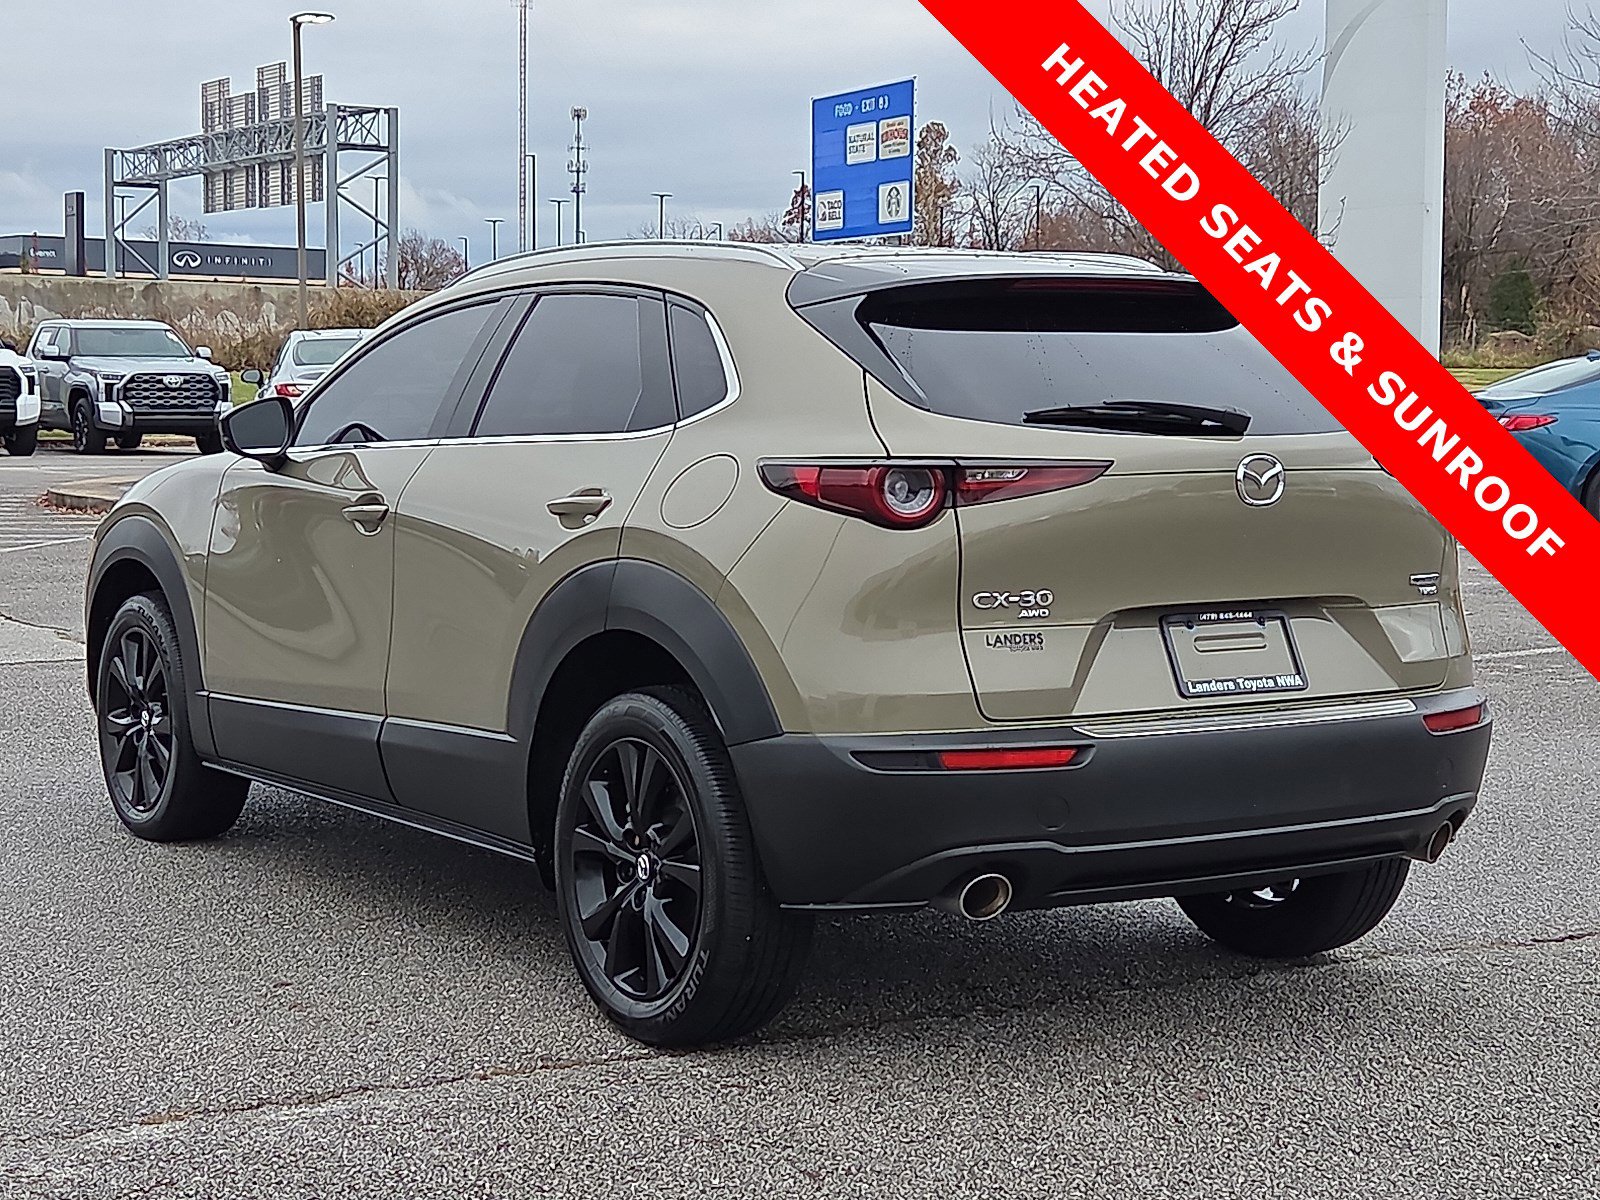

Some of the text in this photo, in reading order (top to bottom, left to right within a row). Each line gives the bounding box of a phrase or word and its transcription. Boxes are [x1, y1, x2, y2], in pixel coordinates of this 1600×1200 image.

[834, 102, 853, 118] FOOD
[862, 97, 876, 112] EXIT
[848, 132, 875, 143] NATURAL
[848, 143, 866, 154] STATE
[827, 199, 843, 210] TACO
[828, 210, 842, 221] BELL
[207, 255, 272, 267] INFINITI
[972, 588, 1054, 609] CX-30
[1018, 608, 1050, 618] AWD
[985, 632, 1044, 648] LANDERS
[1188, 674, 1304, 693] Landers Toyota NWA
